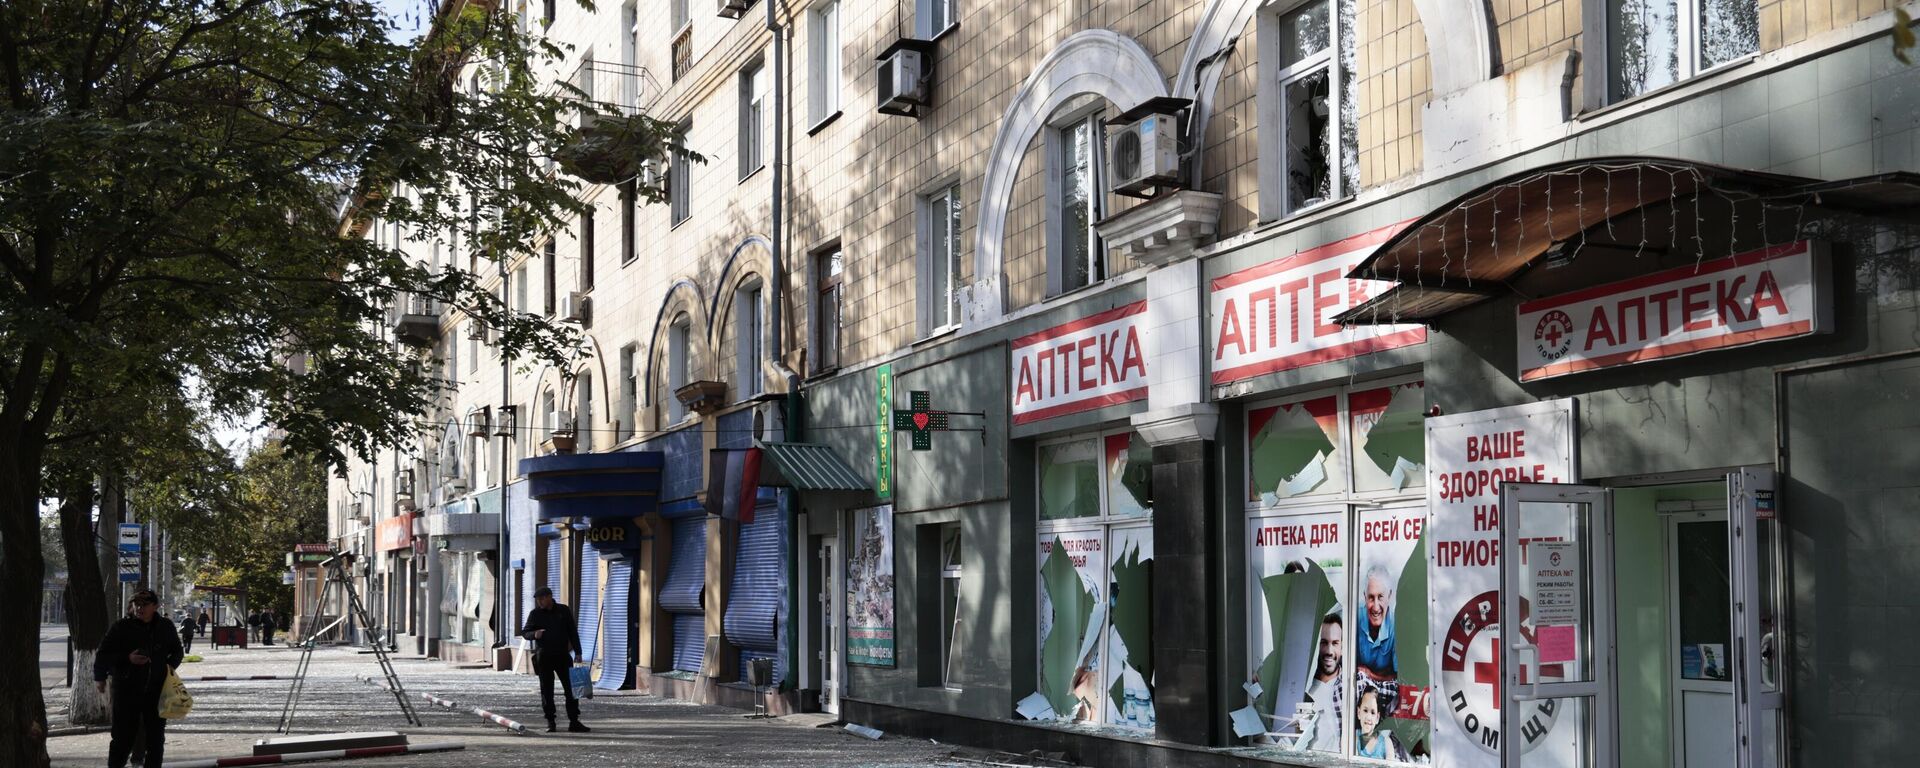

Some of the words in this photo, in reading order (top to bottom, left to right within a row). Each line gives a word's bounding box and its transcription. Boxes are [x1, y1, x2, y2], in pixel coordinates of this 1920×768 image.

[1215, 263, 1395, 361] АПТЕК
[1537, 312, 1571, 336] ПЕРВАЯ
[1583, 270, 1789, 350] АПТЕКА
[1015, 325, 1146, 405] АПТЕКА
[1537, 339, 1571, 360] ПОМОЩЬ
[880, 373, 888, 492] ПРОДУКТЫ
[1467, 430, 1525, 462] ВАШЕ
[1364, 515, 1399, 542] ВСЕЙ
[1403, 518, 1425, 540] СЕ
[1474, 505, 1498, 531] НА
[1256, 525, 1306, 546] АПТЕКА
[1310, 523, 1338, 548] ДЛЯ
[1451, 690, 1556, 750] ПОМЩЬ
